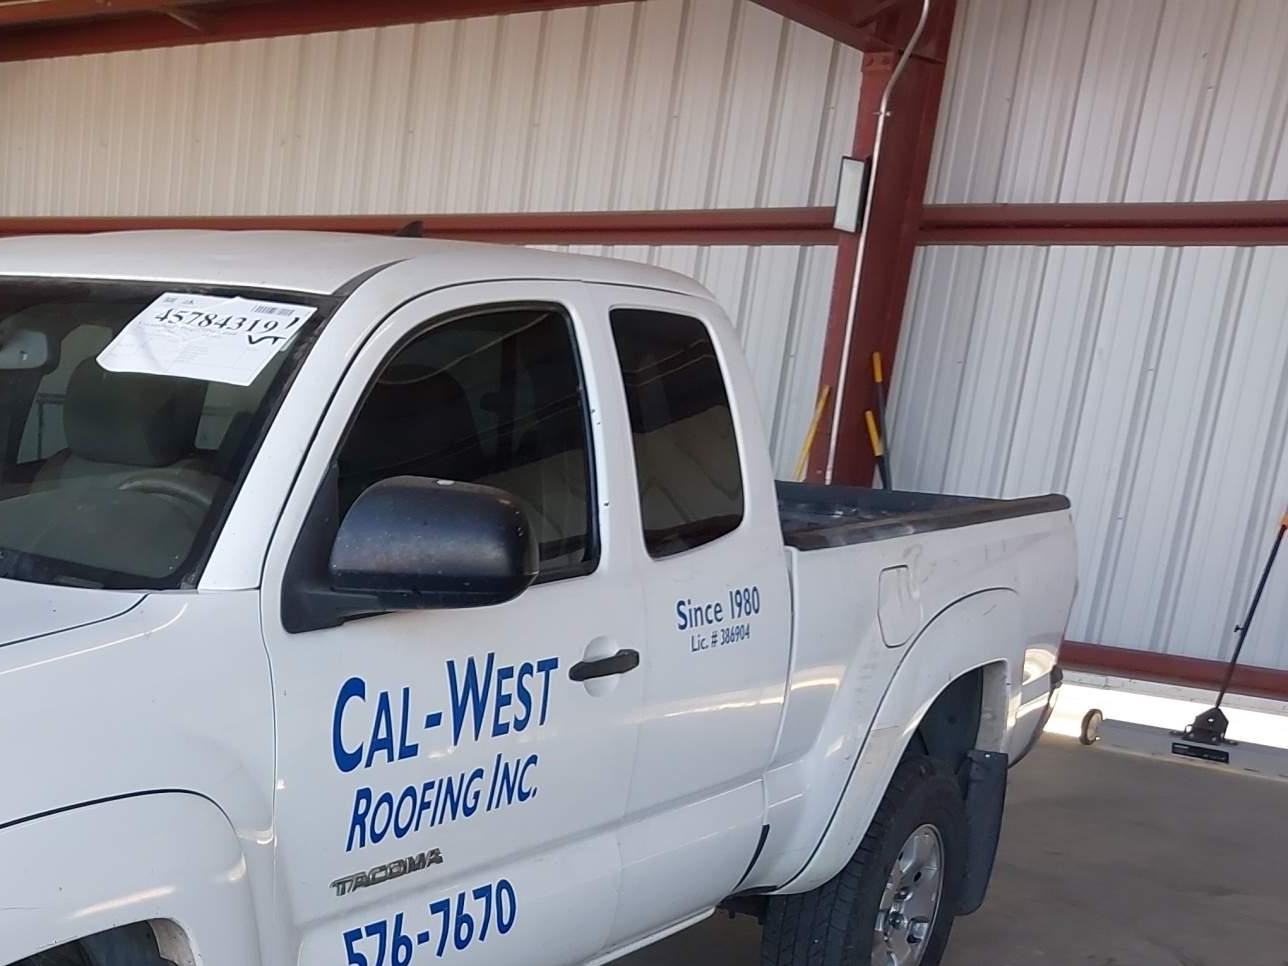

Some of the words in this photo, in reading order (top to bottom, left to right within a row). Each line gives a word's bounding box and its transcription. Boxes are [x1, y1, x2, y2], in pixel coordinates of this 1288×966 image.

[154, 307, 279, 334] 45784319
[676, 598, 724, 631] Since
[728, 585, 761, 620] 1980
[691, 634, 709, 652] Lic.
[720, 623, 751, 646] 386904
[345, 765, 484, 852] ROOFING
[485, 752, 539, 813] INC.
[329, 847, 444, 897] TACOMA
